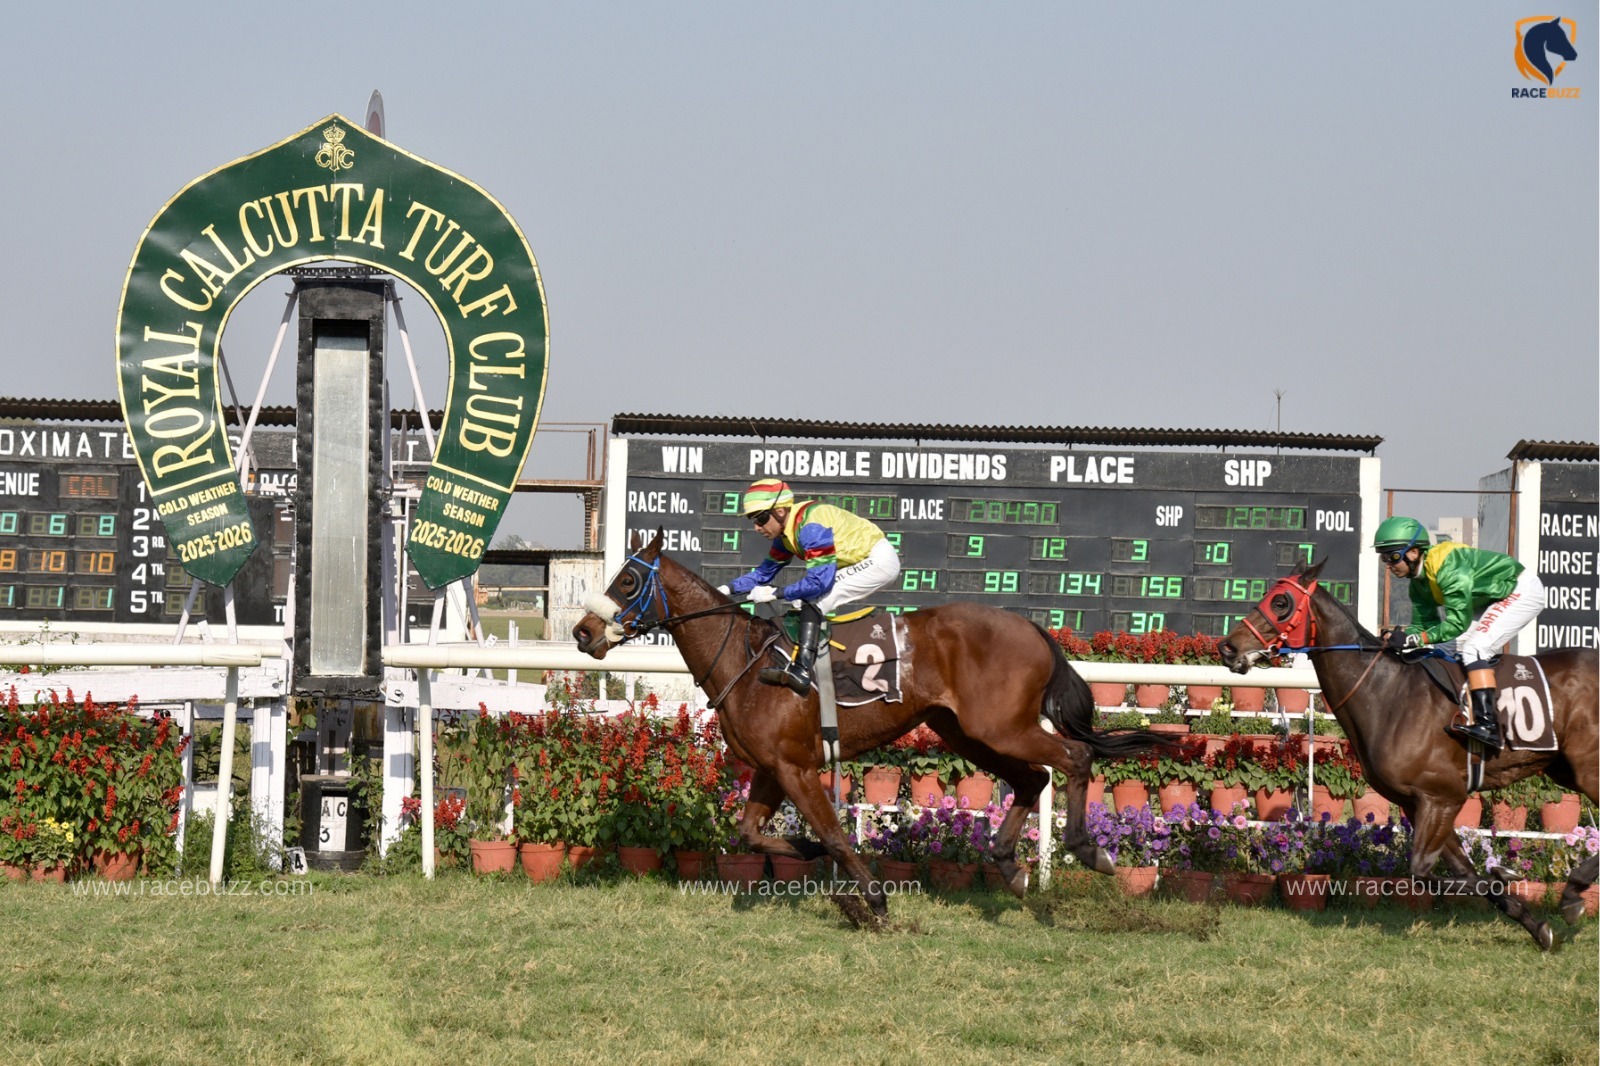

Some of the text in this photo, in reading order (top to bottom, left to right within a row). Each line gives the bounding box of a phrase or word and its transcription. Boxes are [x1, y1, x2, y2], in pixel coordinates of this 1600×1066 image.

[142, 183, 526, 478] ROYAL CALCUTTA TURF CLUB
[661, 446, 1272, 487] WIN PROBABLE DIVIDENDS PLACE SHP
[68, 476, 110, 496] CAL
[426, 475, 499, 512] COLD WEATHER
[158, 497, 188, 516] COLD
[188, 481, 237, 507] WEATHER
[628, 490, 694, 515] RACE No.
[722, 493, 740, 514] 3
[900, 498, 944, 520] PLACE
[186, 503, 229, 526] SEASON
[442, 502, 485, 528] SEASON
[969, 501, 1056, 524] 28490
[1156, 505, 1184, 527] SHP
[1225, 507, 1304, 529] 12640
[1315, 509, 1354, 532] POOL
[48, 514, 66, 535] 6
[98, 515, 115, 536] 8
[1541, 513, 1583, 537] RACE
[177, 521, 252, 562] 2025-2026
[410, 518, 485, 559] 2025-2026
[680, 530, 702, 552] No.
[723, 530, 739, 551] 4
[967, 536, 985, 557] 9
[1041, 538, 1066, 559] 12
[41, 551, 66, 572] 10
[1130, 540, 1148, 561] 3
[1205, 543, 1229, 564] 10
[1298, 544, 1314, 565] 7
[90, 552, 115, 573] 10
[1539, 550, 1592, 575] HORSE
[902, 570, 937, 591] 64
[984, 571, 1018, 593] 99
[1059, 573, 1102, 595] 134
[1141, 577, 1183, 598] 156
[1224, 579, 1266, 601] 158
[1050, 610, 1082, 631] 31
[1130, 612, 1164, 634] 30
[854, 643, 889, 692] 2
[1497, 685, 1545, 742] 10
[337, 801, 346, 817] C
[319, 825, 330, 842] 3
